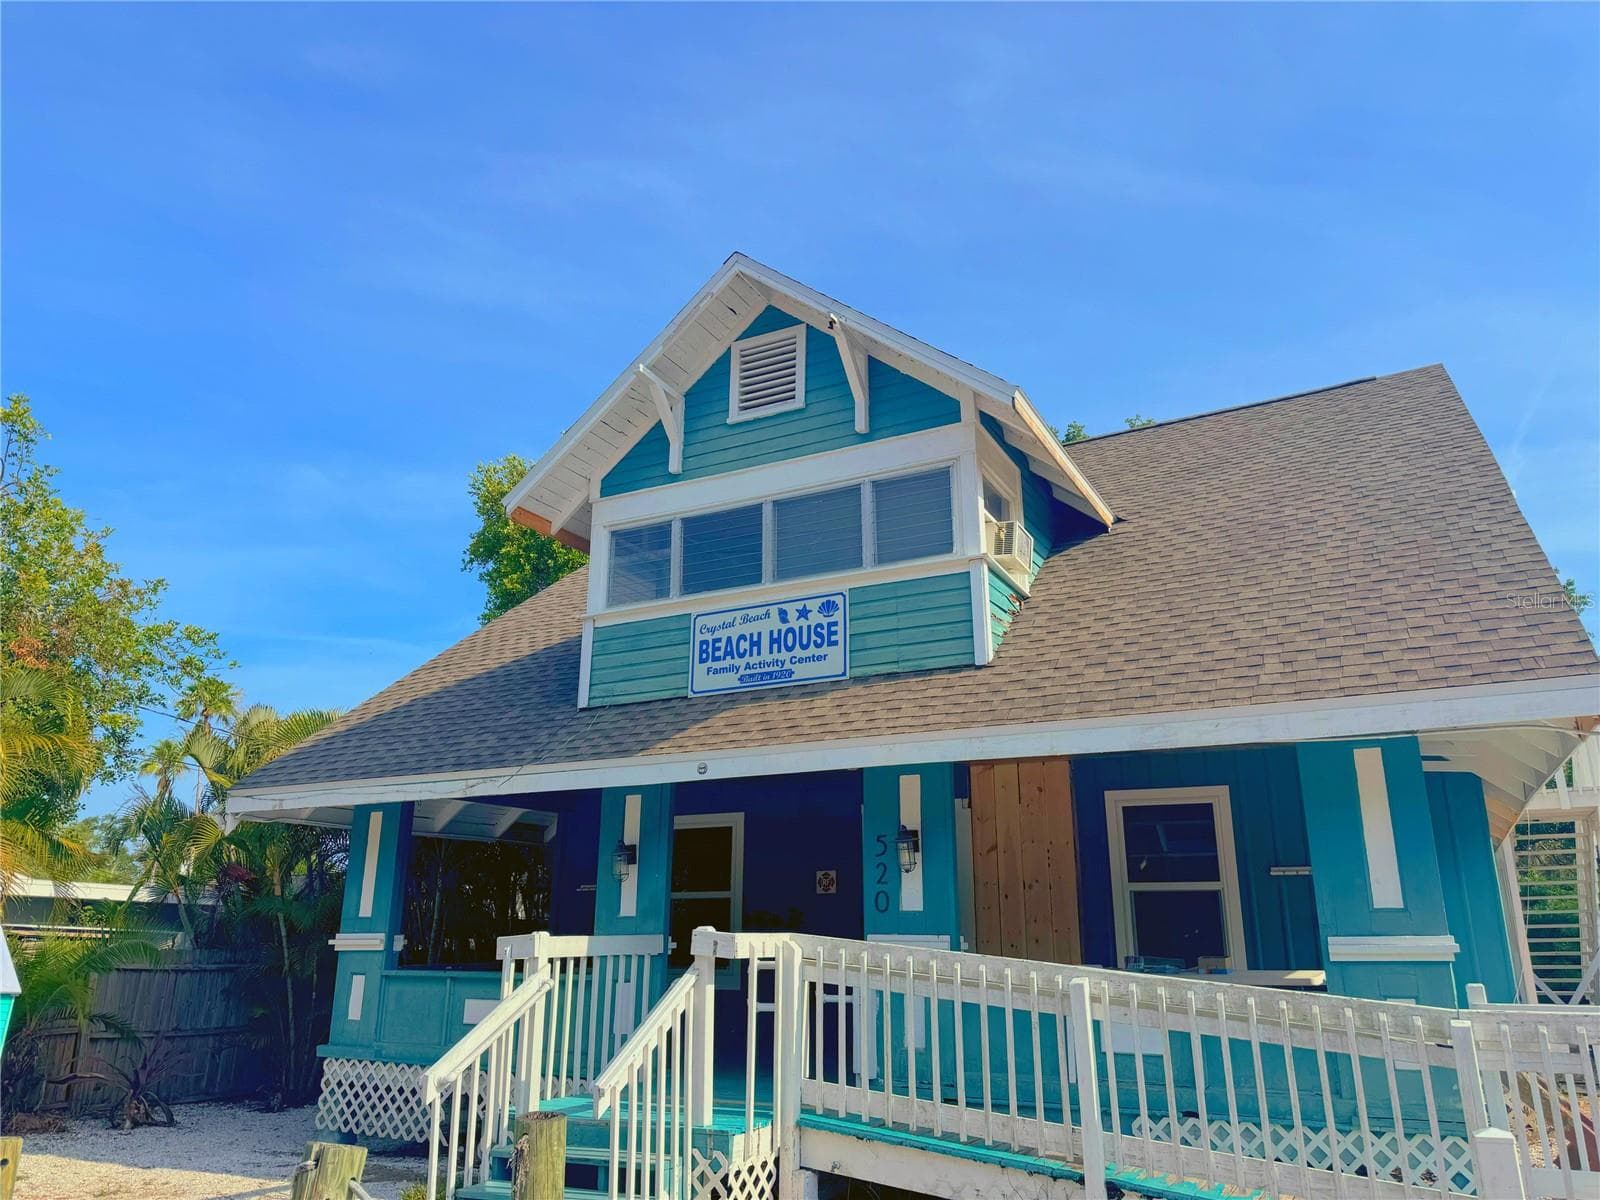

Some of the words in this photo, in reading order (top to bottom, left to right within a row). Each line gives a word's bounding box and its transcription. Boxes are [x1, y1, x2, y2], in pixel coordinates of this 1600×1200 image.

[699, 617, 737, 636] Crystal
[739, 609, 771, 625] Beach
[698, 631, 762, 664] BEACH
[768, 621, 839, 654] HOUSE
[706, 663, 741, 676] Family
[743, 658, 786, 672] Activity
[789, 653, 829, 665] Center
[874, 834, 890, 913] 520
